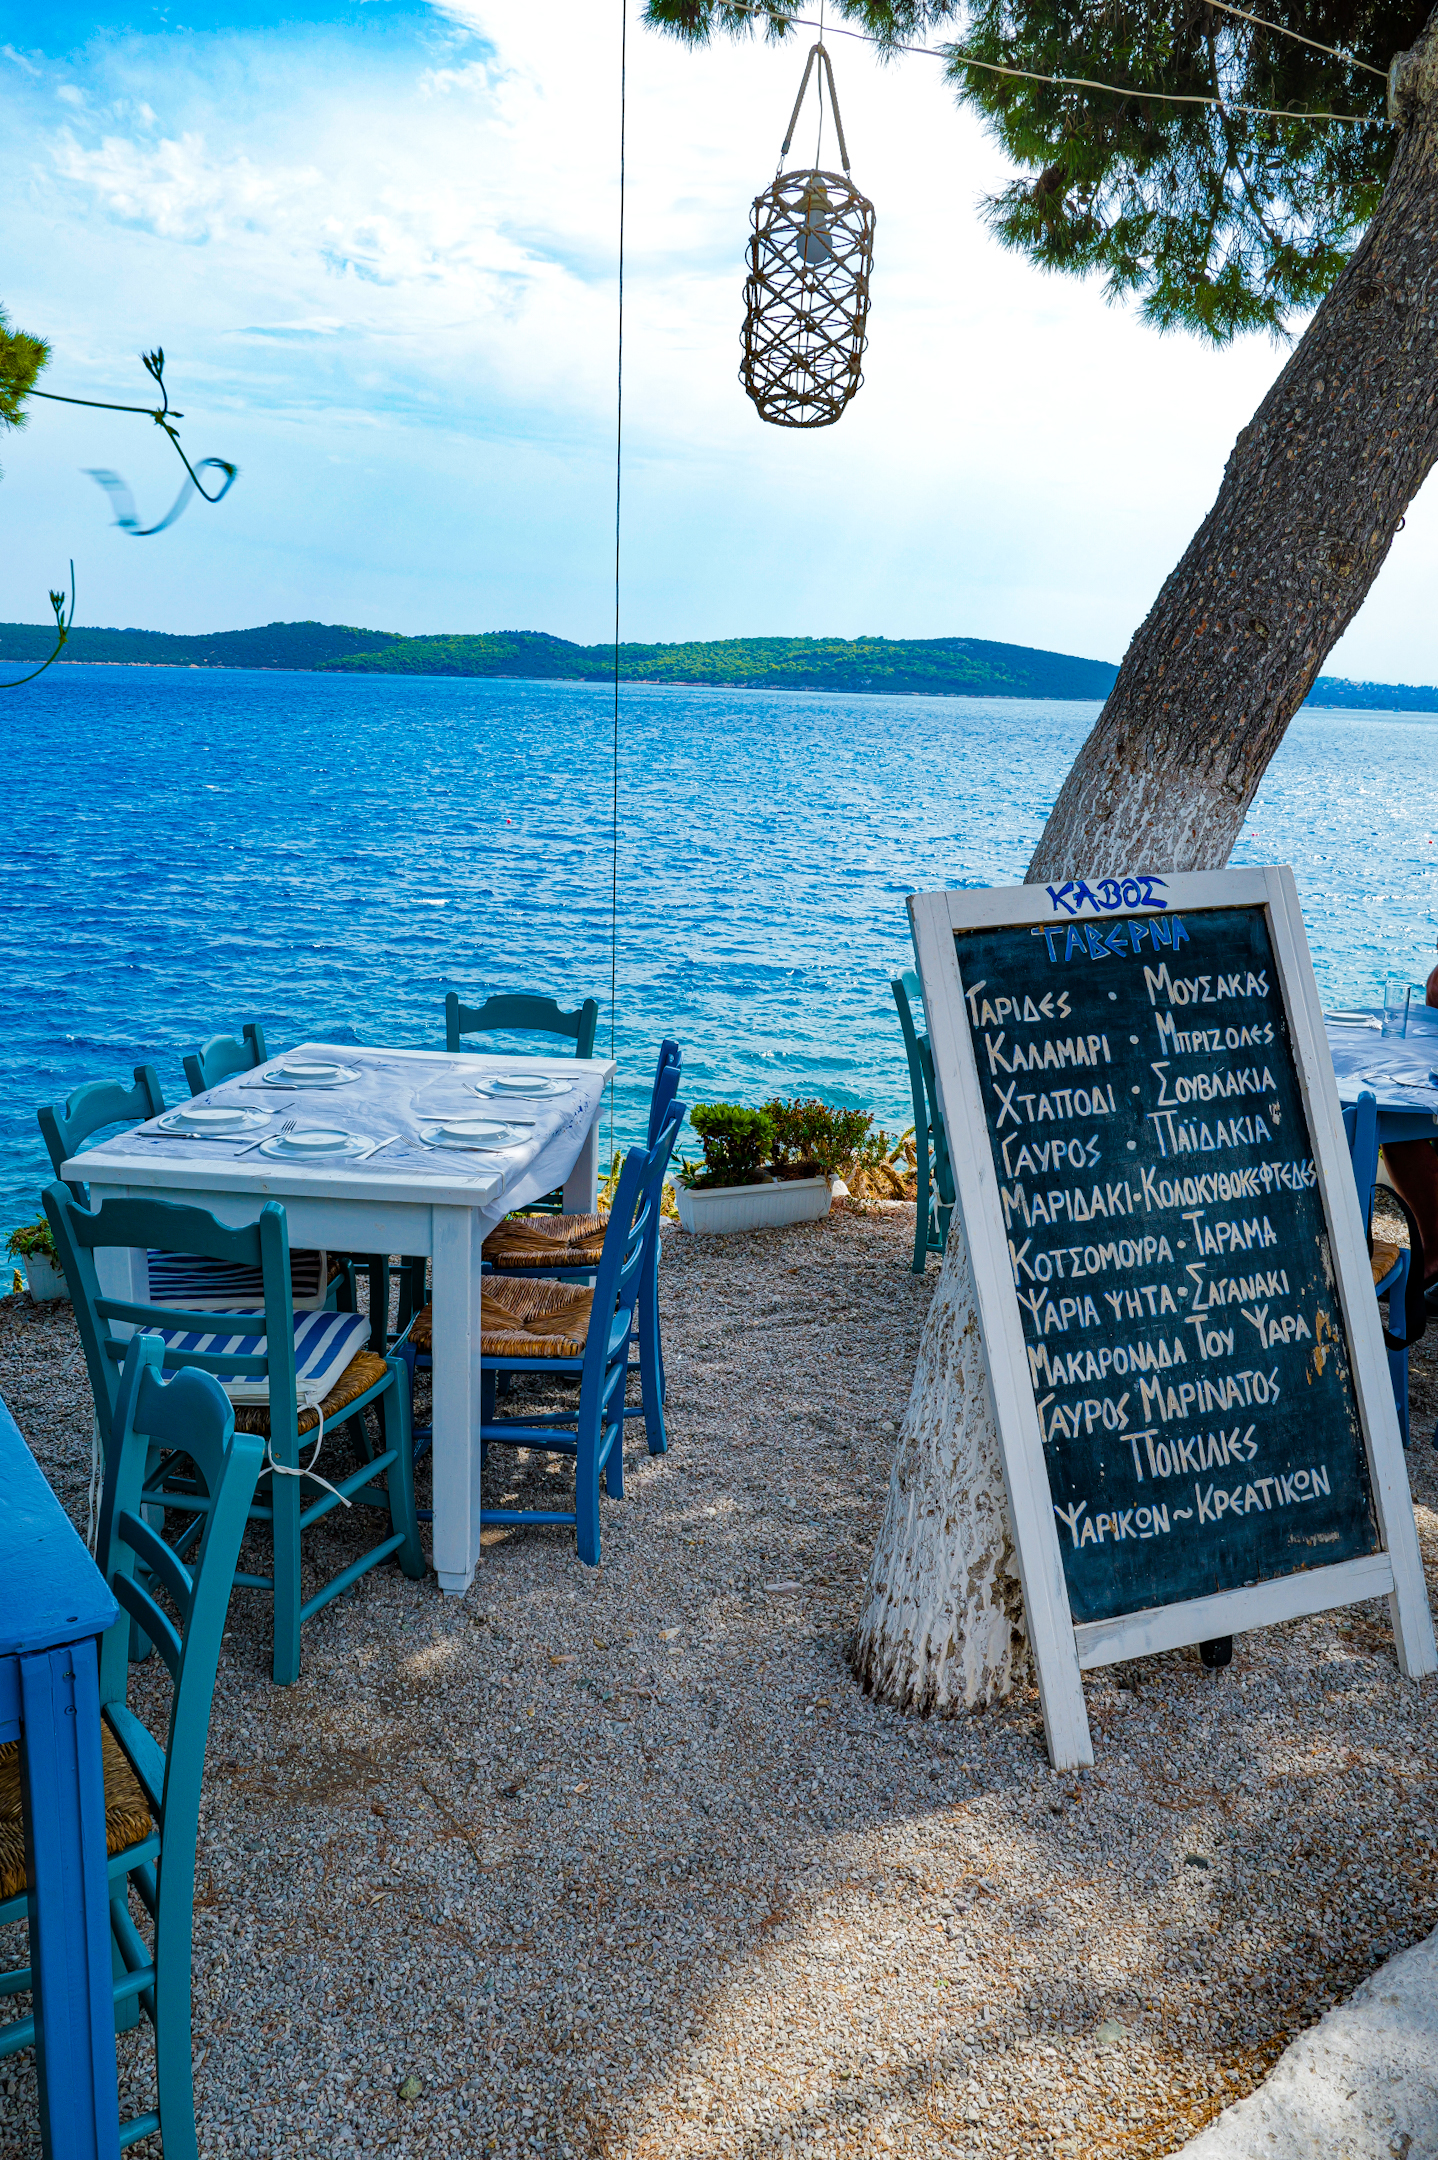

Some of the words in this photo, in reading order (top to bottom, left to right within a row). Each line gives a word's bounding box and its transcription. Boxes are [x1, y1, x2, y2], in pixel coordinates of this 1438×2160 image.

[1045, 876, 1170, 915] ΚΑΒΟΣ
[1031, 914, 1190, 962] ΤΑΒΕΡΝΑ
[964, 979, 1072, 1029] ΓΑΡΙΔΕΣ
[1143, 962, 1270, 1006] ΜΟΥΣΑΚΑΣ
[984, 1031, 1111, 1076] ΚΑΛΑΜΑΡΙ
[1155, 1010, 1275, 1056] ΜΠΡΙΖΟΛΕΣ
[992, 1080, 1117, 1128] ΧΤΑΠΟΔΙ
[1150, 1061, 1277, 1106] ΣΟΥΒΛΑΚΙΑ
[1000, 1132, 1101, 1178] ΓΑΥΡΟΣ
[1000, 1181, 1132, 1229] ΜΑΡΙΔΑΚΙ
[1140, 1159, 1317, 1212] ΚΟΛΟΚΥΘΟΚΕΦΤΕΔΕΣ
[1007, 1234, 1174, 1286] ΚΟΤΣΟΜΟΥΡΑ
[1181, 1210, 1277, 1257] ΤΑΡΑΜΑ
[1016, 1286, 1101, 1335] ΨΑΡΙΑ
[1103, 1284, 1178, 1321] ΨΗΤΑ
[1186, 1262, 1290, 1311] ΣΑΓΑΝΑΚΙ
[1026, 1336, 1187, 1389] ΜΑΚΑΡΟΝΑΔΑ
[1184, 1314, 1234, 1361] ΤΟΥ
[1241, 1303, 1312, 1350] ΨΑΡΑ
[1036, 1392, 1130, 1443] ΓΑΥΡΟΣ
[1139, 1366, 1280, 1424] ΜΑΡΙΝΑΤΟΣ
[1054, 1501, 1170, 1549] ΨΑΡΙΚΩΝ
[1194, 1464, 1331, 1524] ΚΡΕΑΤΙΚΩΝ
